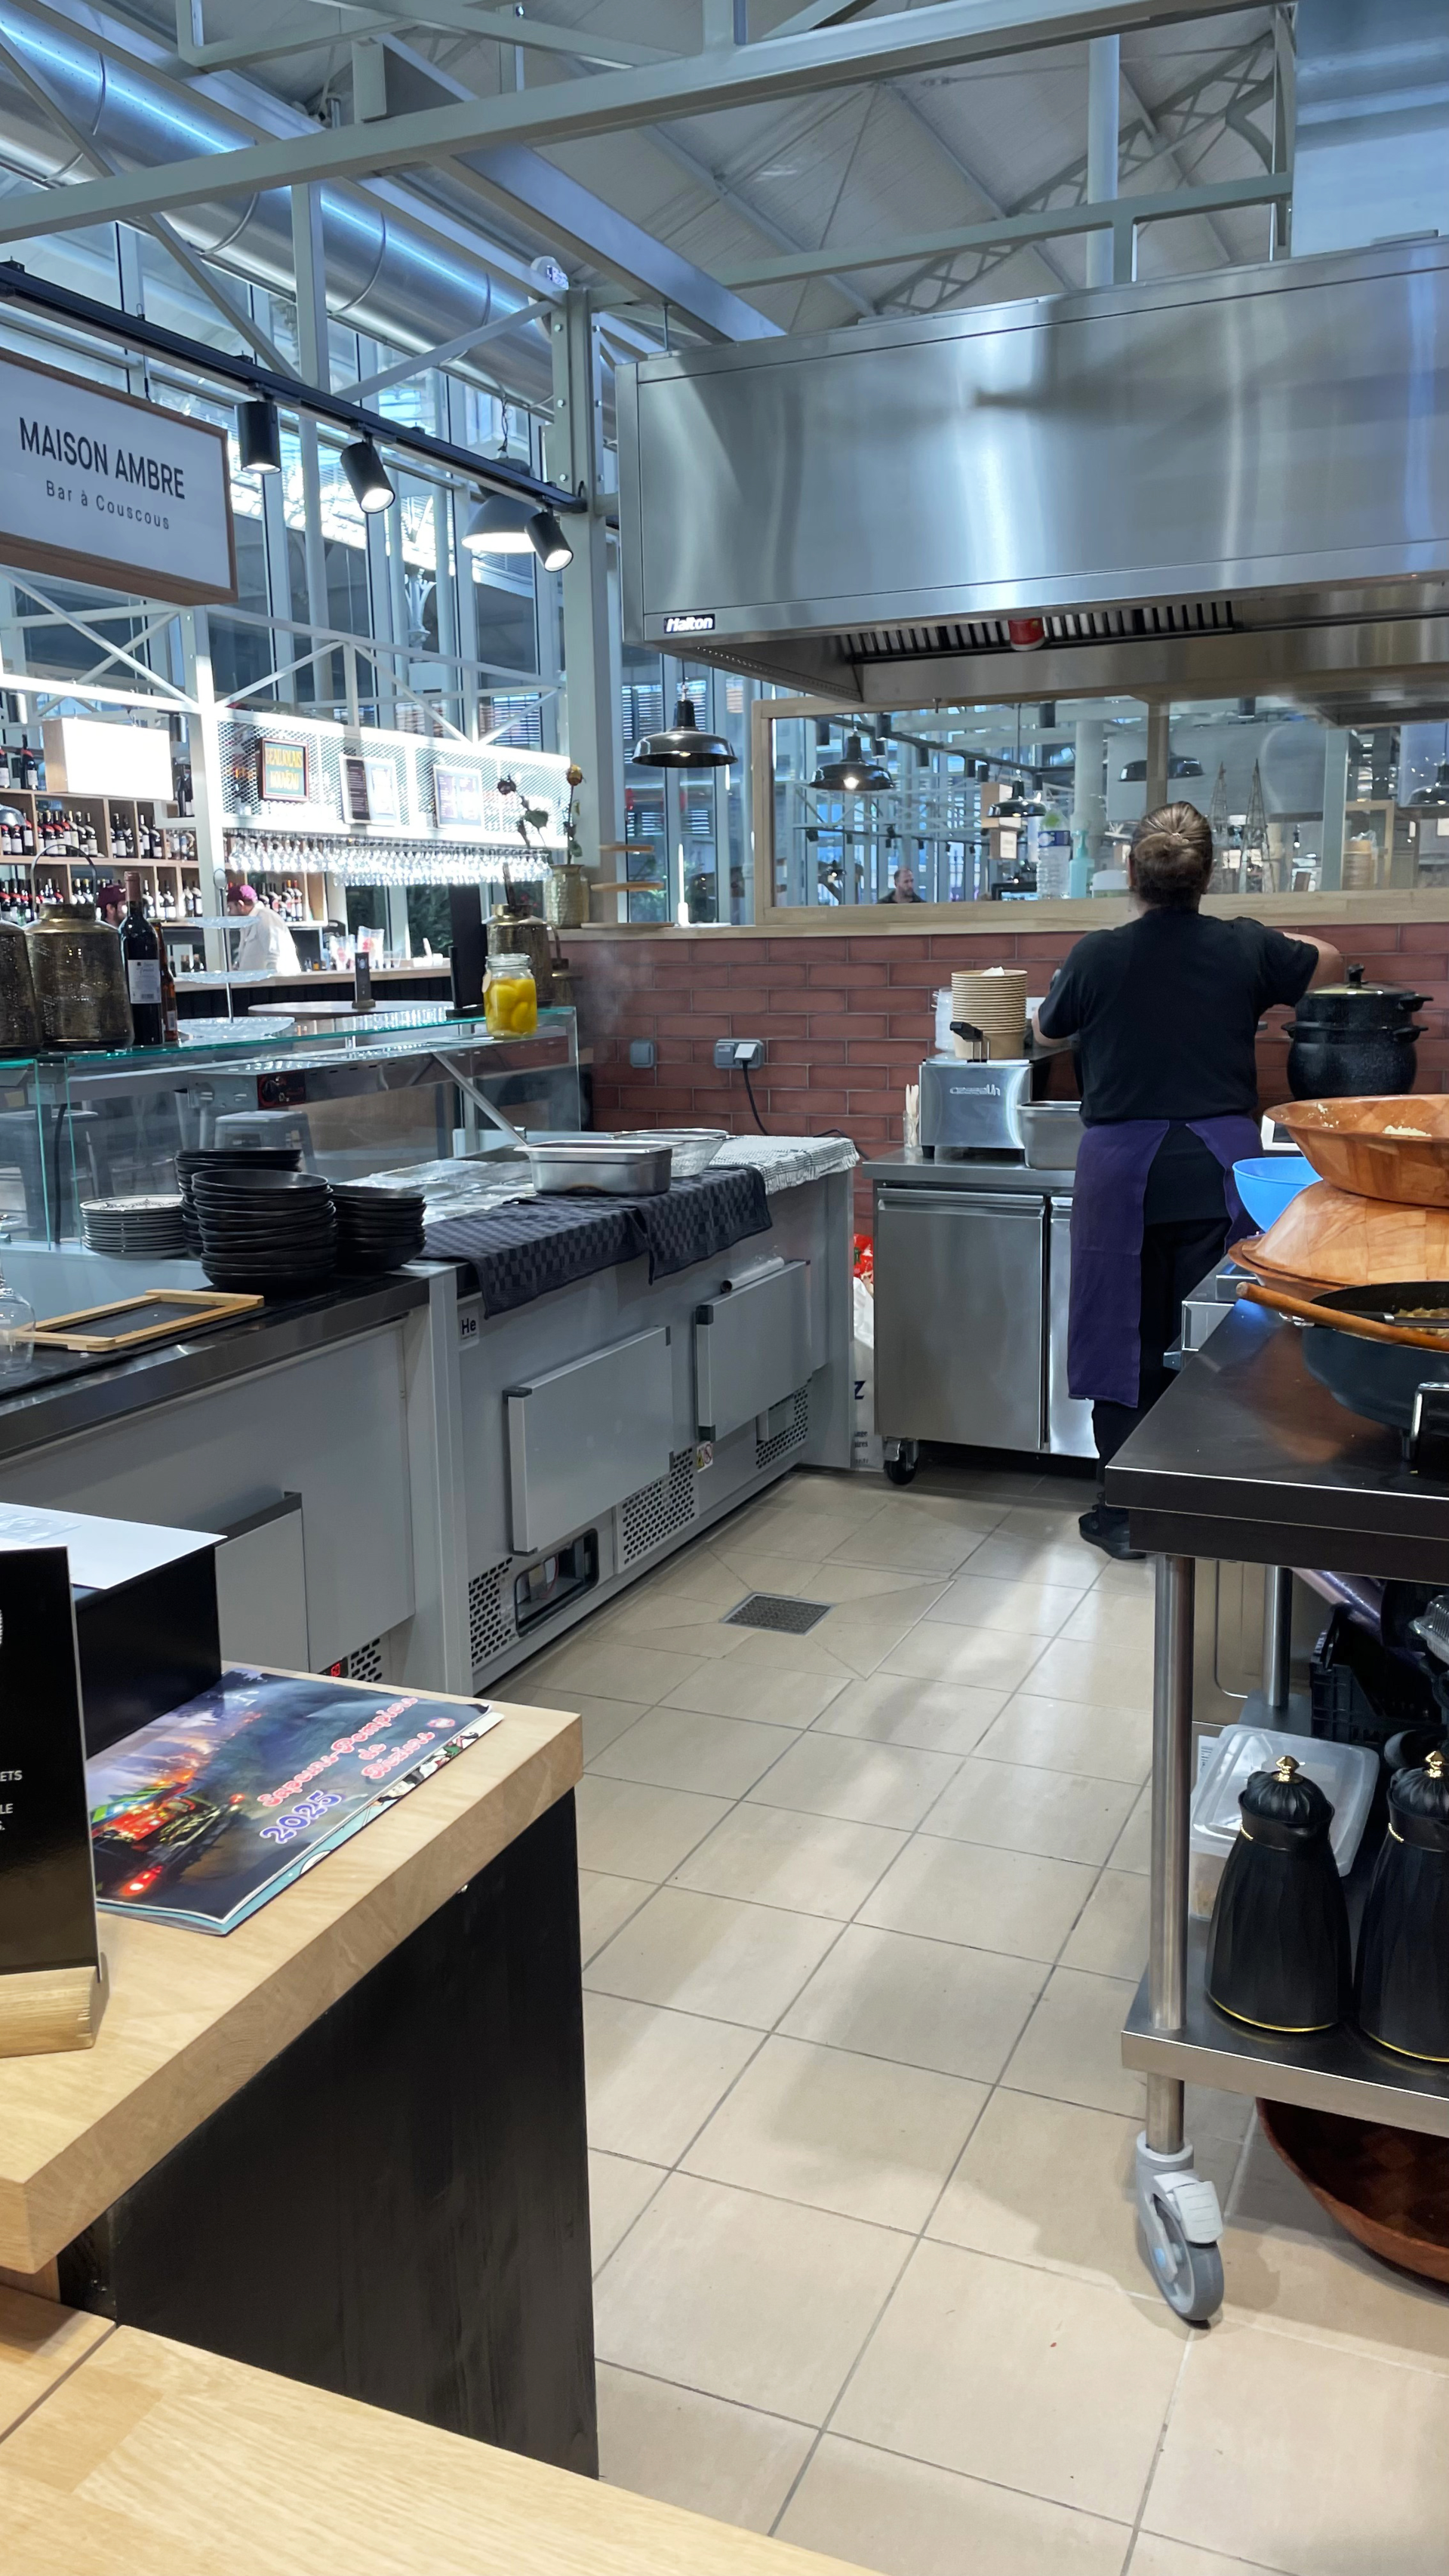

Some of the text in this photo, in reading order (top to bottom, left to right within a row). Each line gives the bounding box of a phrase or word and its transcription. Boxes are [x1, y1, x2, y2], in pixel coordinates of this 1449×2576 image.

[20, 417, 185, 500] MAISON AMBRE
[46, 480, 170, 530] Bar à Couscous
[666, 616, 713, 632] Halton
[461, 1318, 476, 1335] He
[257, 1697, 418, 1807] Sapeurs-Pompiers
[358, 1743, 386, 1760] de
[260, 1790, 342, 1844] 2025
